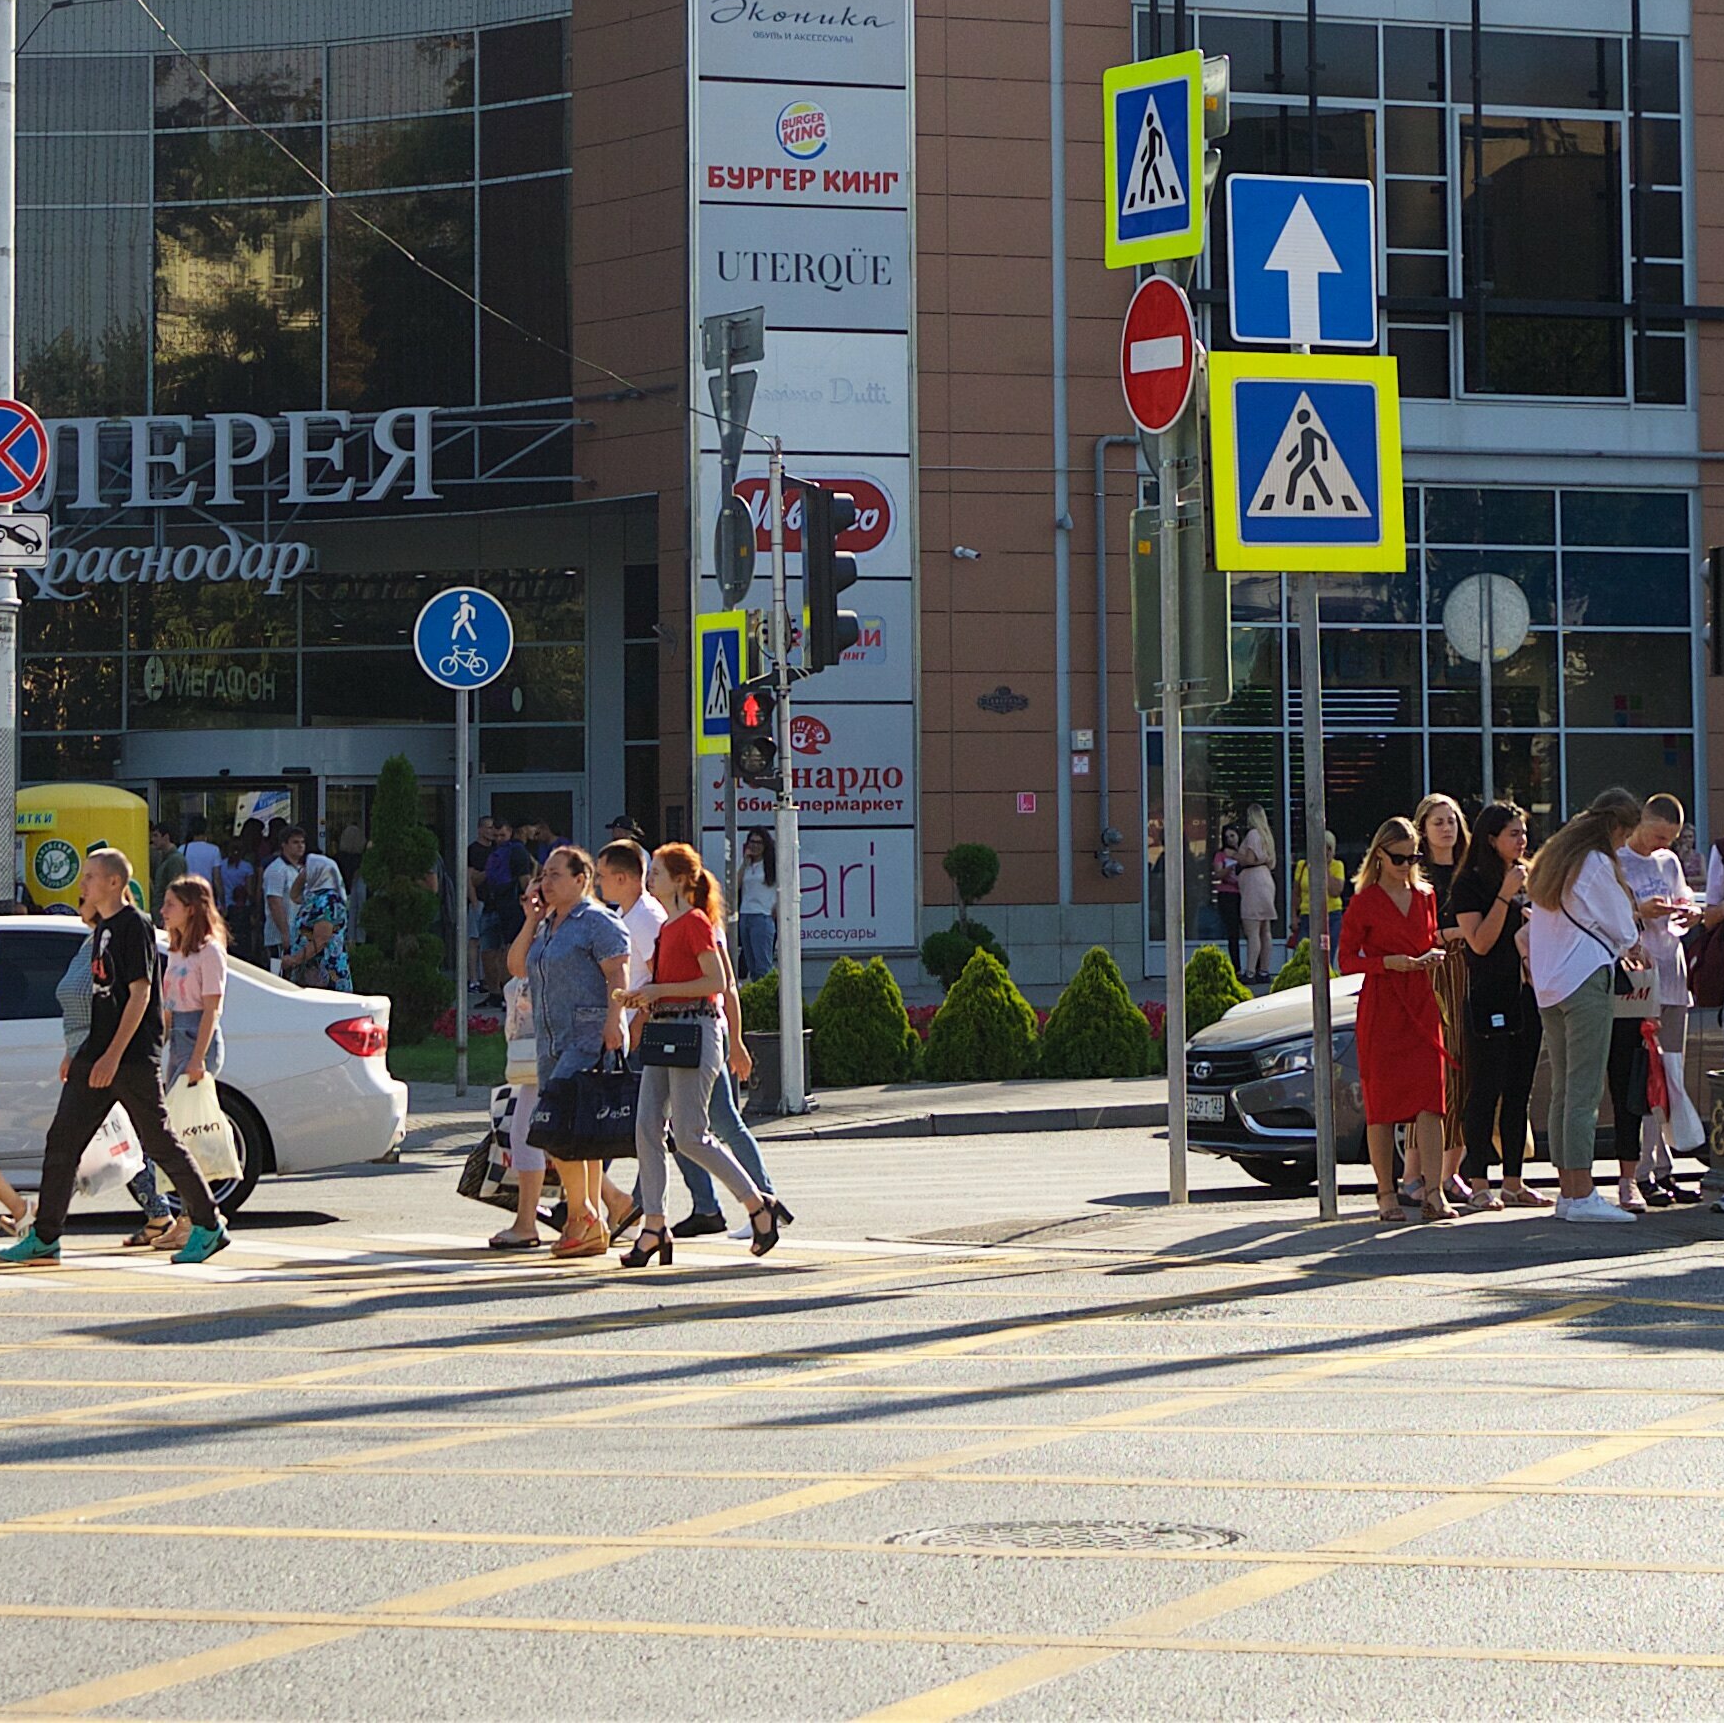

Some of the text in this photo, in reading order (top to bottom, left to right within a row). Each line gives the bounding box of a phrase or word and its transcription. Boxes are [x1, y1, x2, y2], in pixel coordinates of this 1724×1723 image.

[781, 111, 825, 131] BURGER
[782, 123, 826, 146] KING
[707, 165, 899, 195] БУРГЕР КИНГ
[717, 247, 892, 292] UTERQÜE
[829, 377, 892, 404] Dutti
[713, 766, 904, 797] нардо
[713, 796, 904, 814] хбби-пермаркет
[17, 813, 54, 824] ИТКИ
[798, 840, 876, 920] ari
[800, 928, 877, 941] аксессуары
